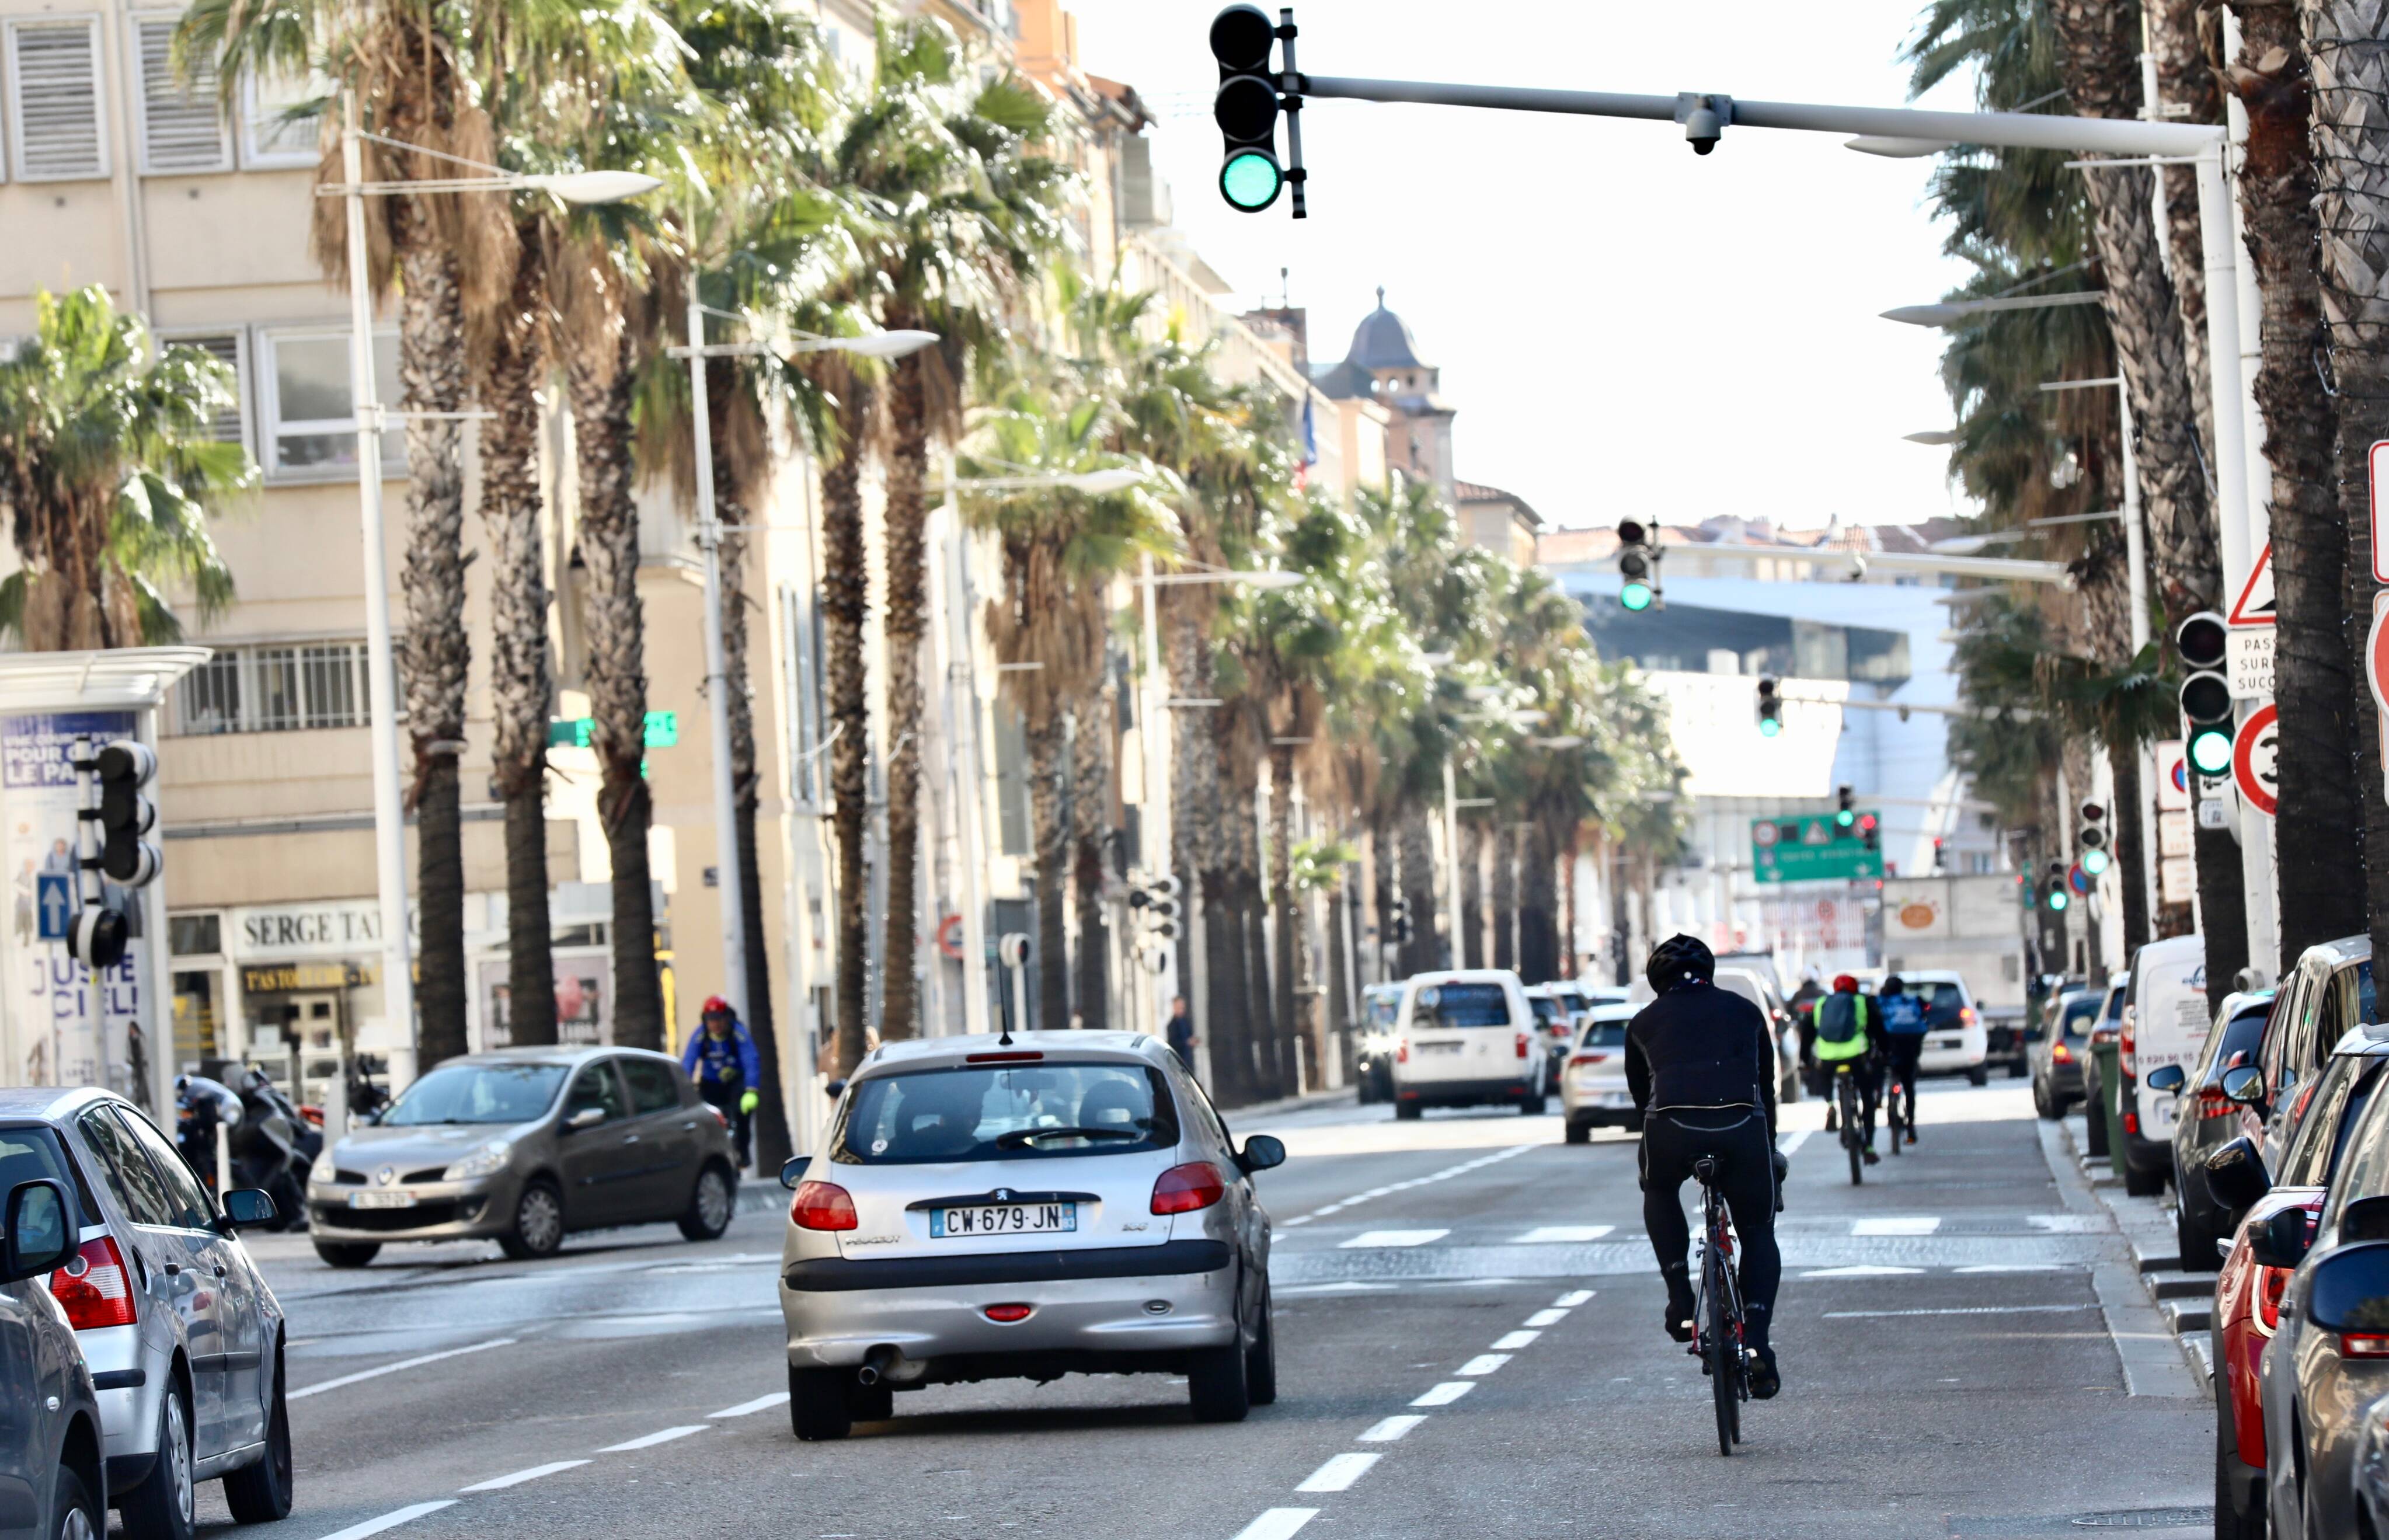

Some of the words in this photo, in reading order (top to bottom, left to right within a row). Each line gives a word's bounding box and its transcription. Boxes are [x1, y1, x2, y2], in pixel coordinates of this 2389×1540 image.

[2245, 638, 2276, 650] PAS
[2241, 657, 2269, 670] SUR
[6, 746, 61, 762] POUR
[2260, 737, 2279, 784] 3
[8, 764, 37, 785] LE
[244, 912, 330, 947] SERGE
[948, 1206, 1059, 1232] CW-679-JN
